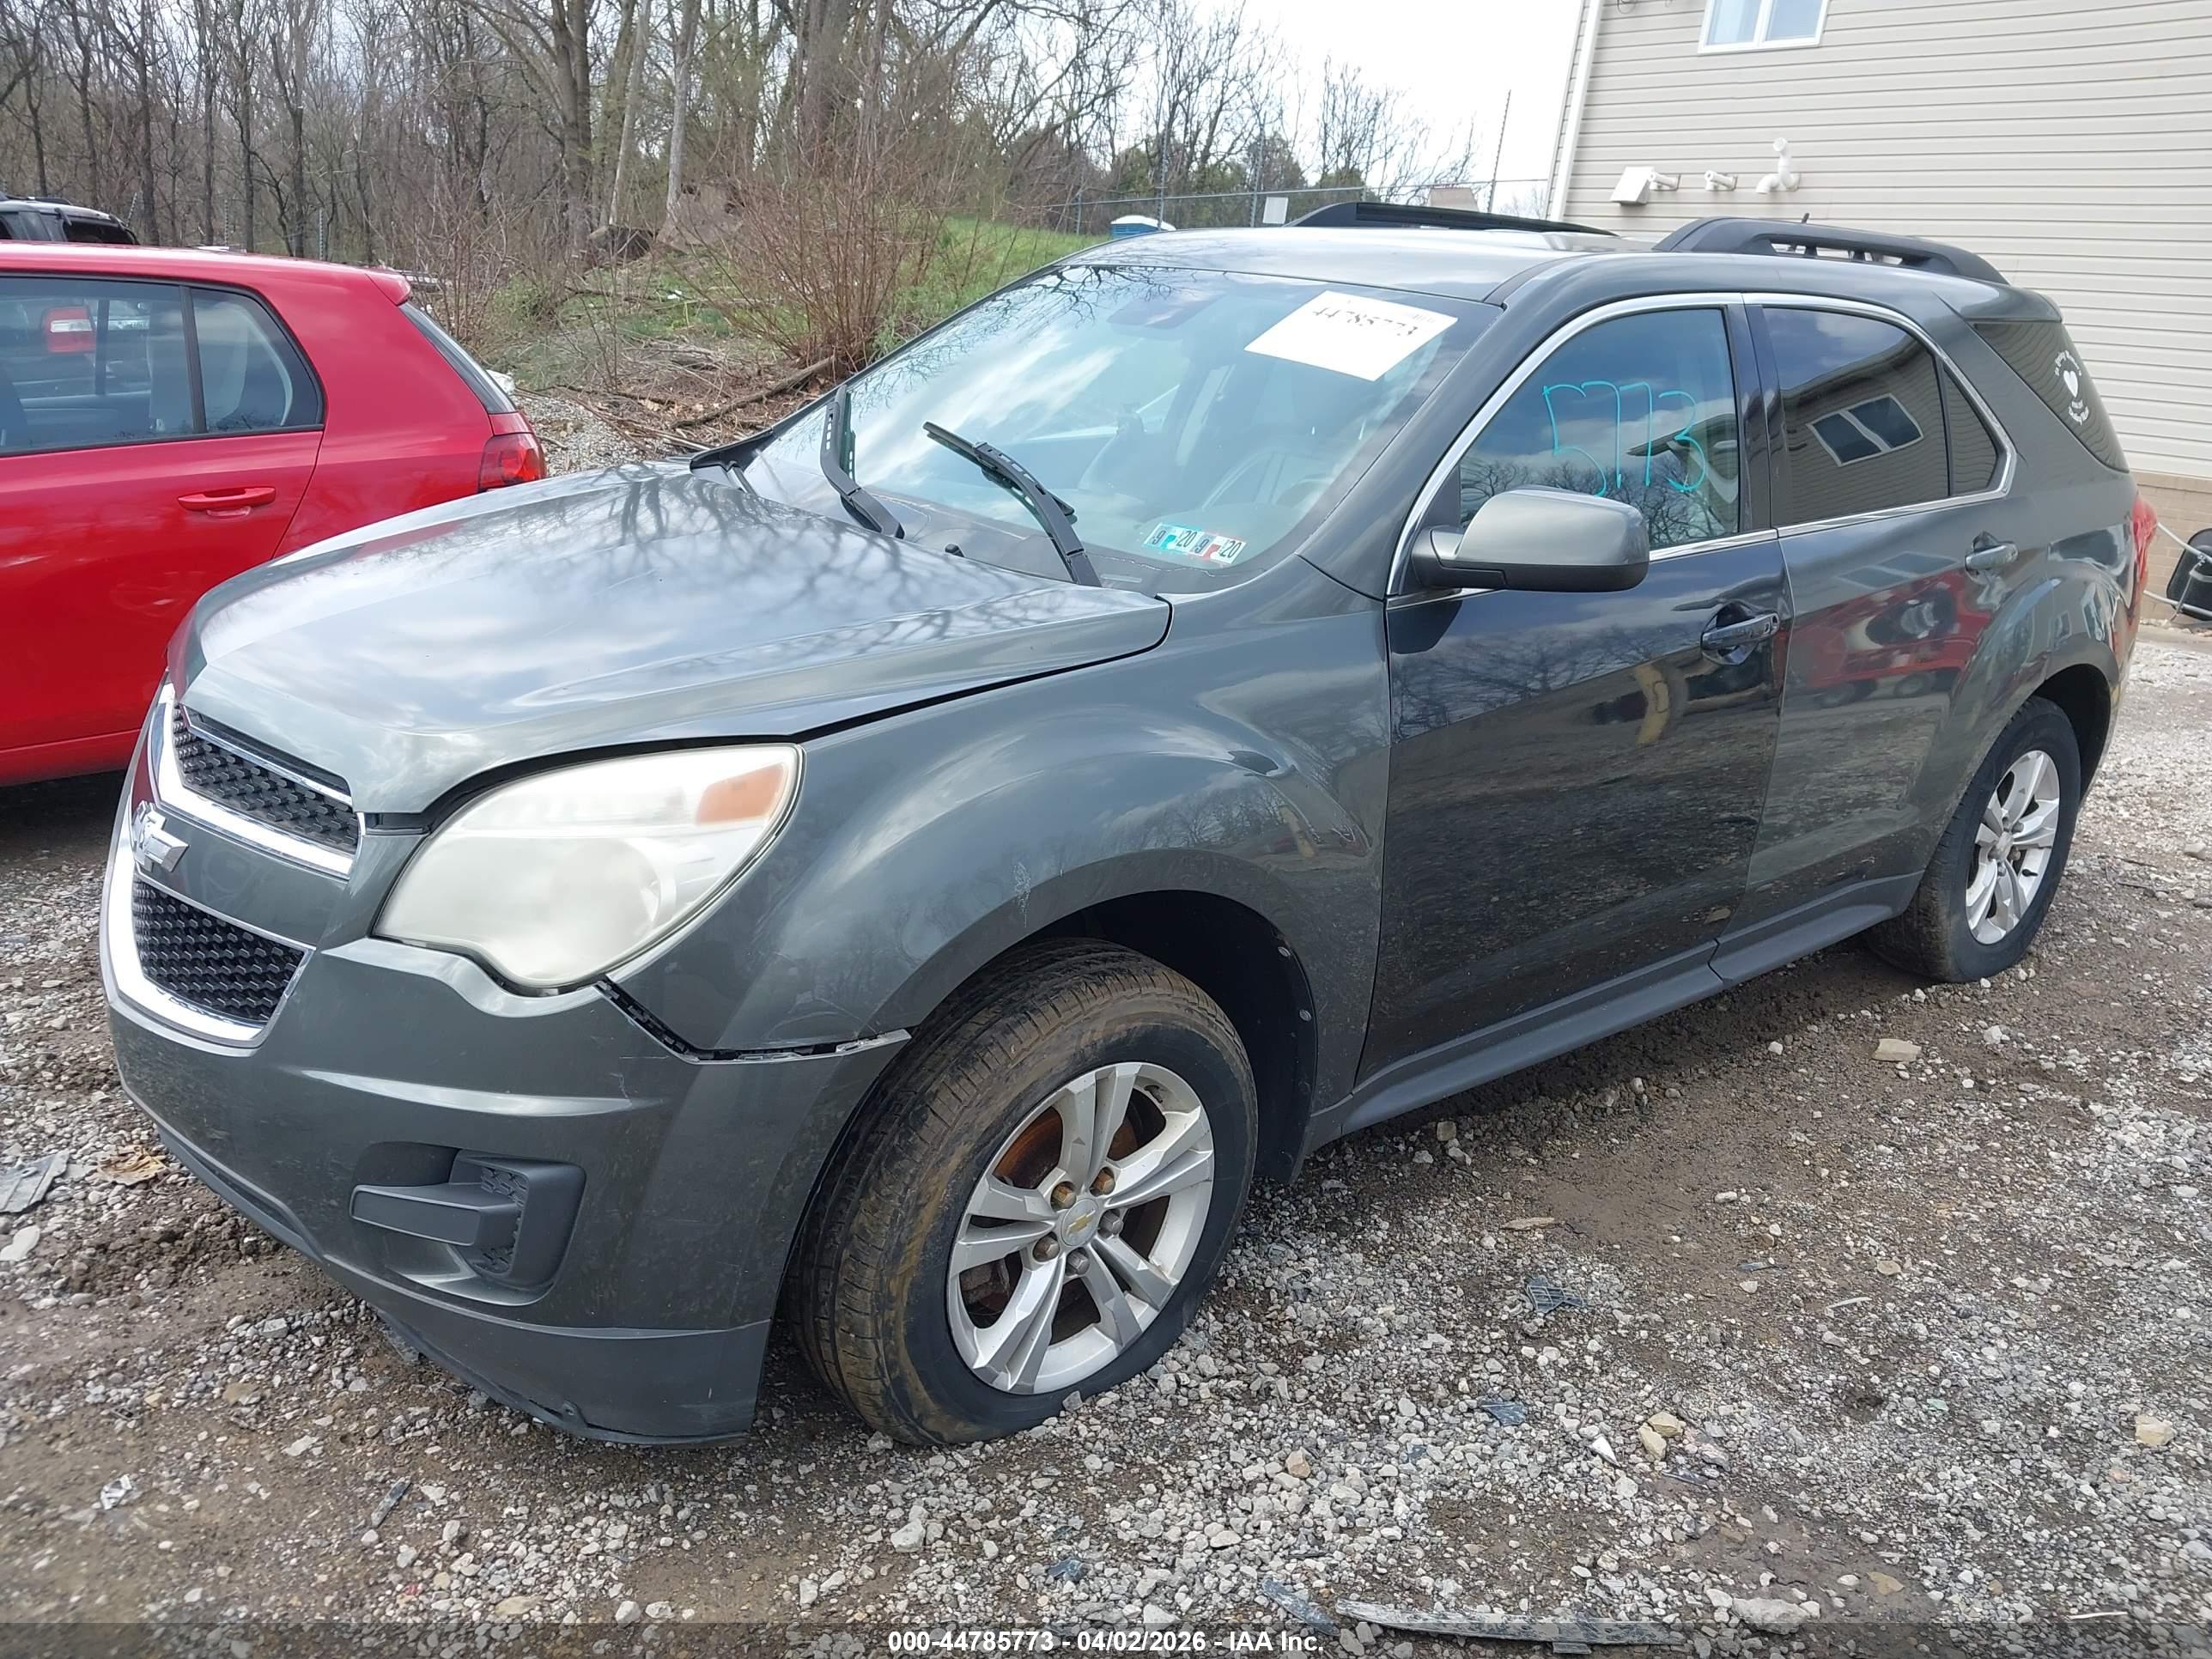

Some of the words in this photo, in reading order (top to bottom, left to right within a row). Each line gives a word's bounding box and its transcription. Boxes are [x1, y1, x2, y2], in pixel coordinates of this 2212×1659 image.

[1542, 380, 1705, 496] 5773
[1176, 530, 1198, 548] 20
[1220, 540, 1242, 558] 20
